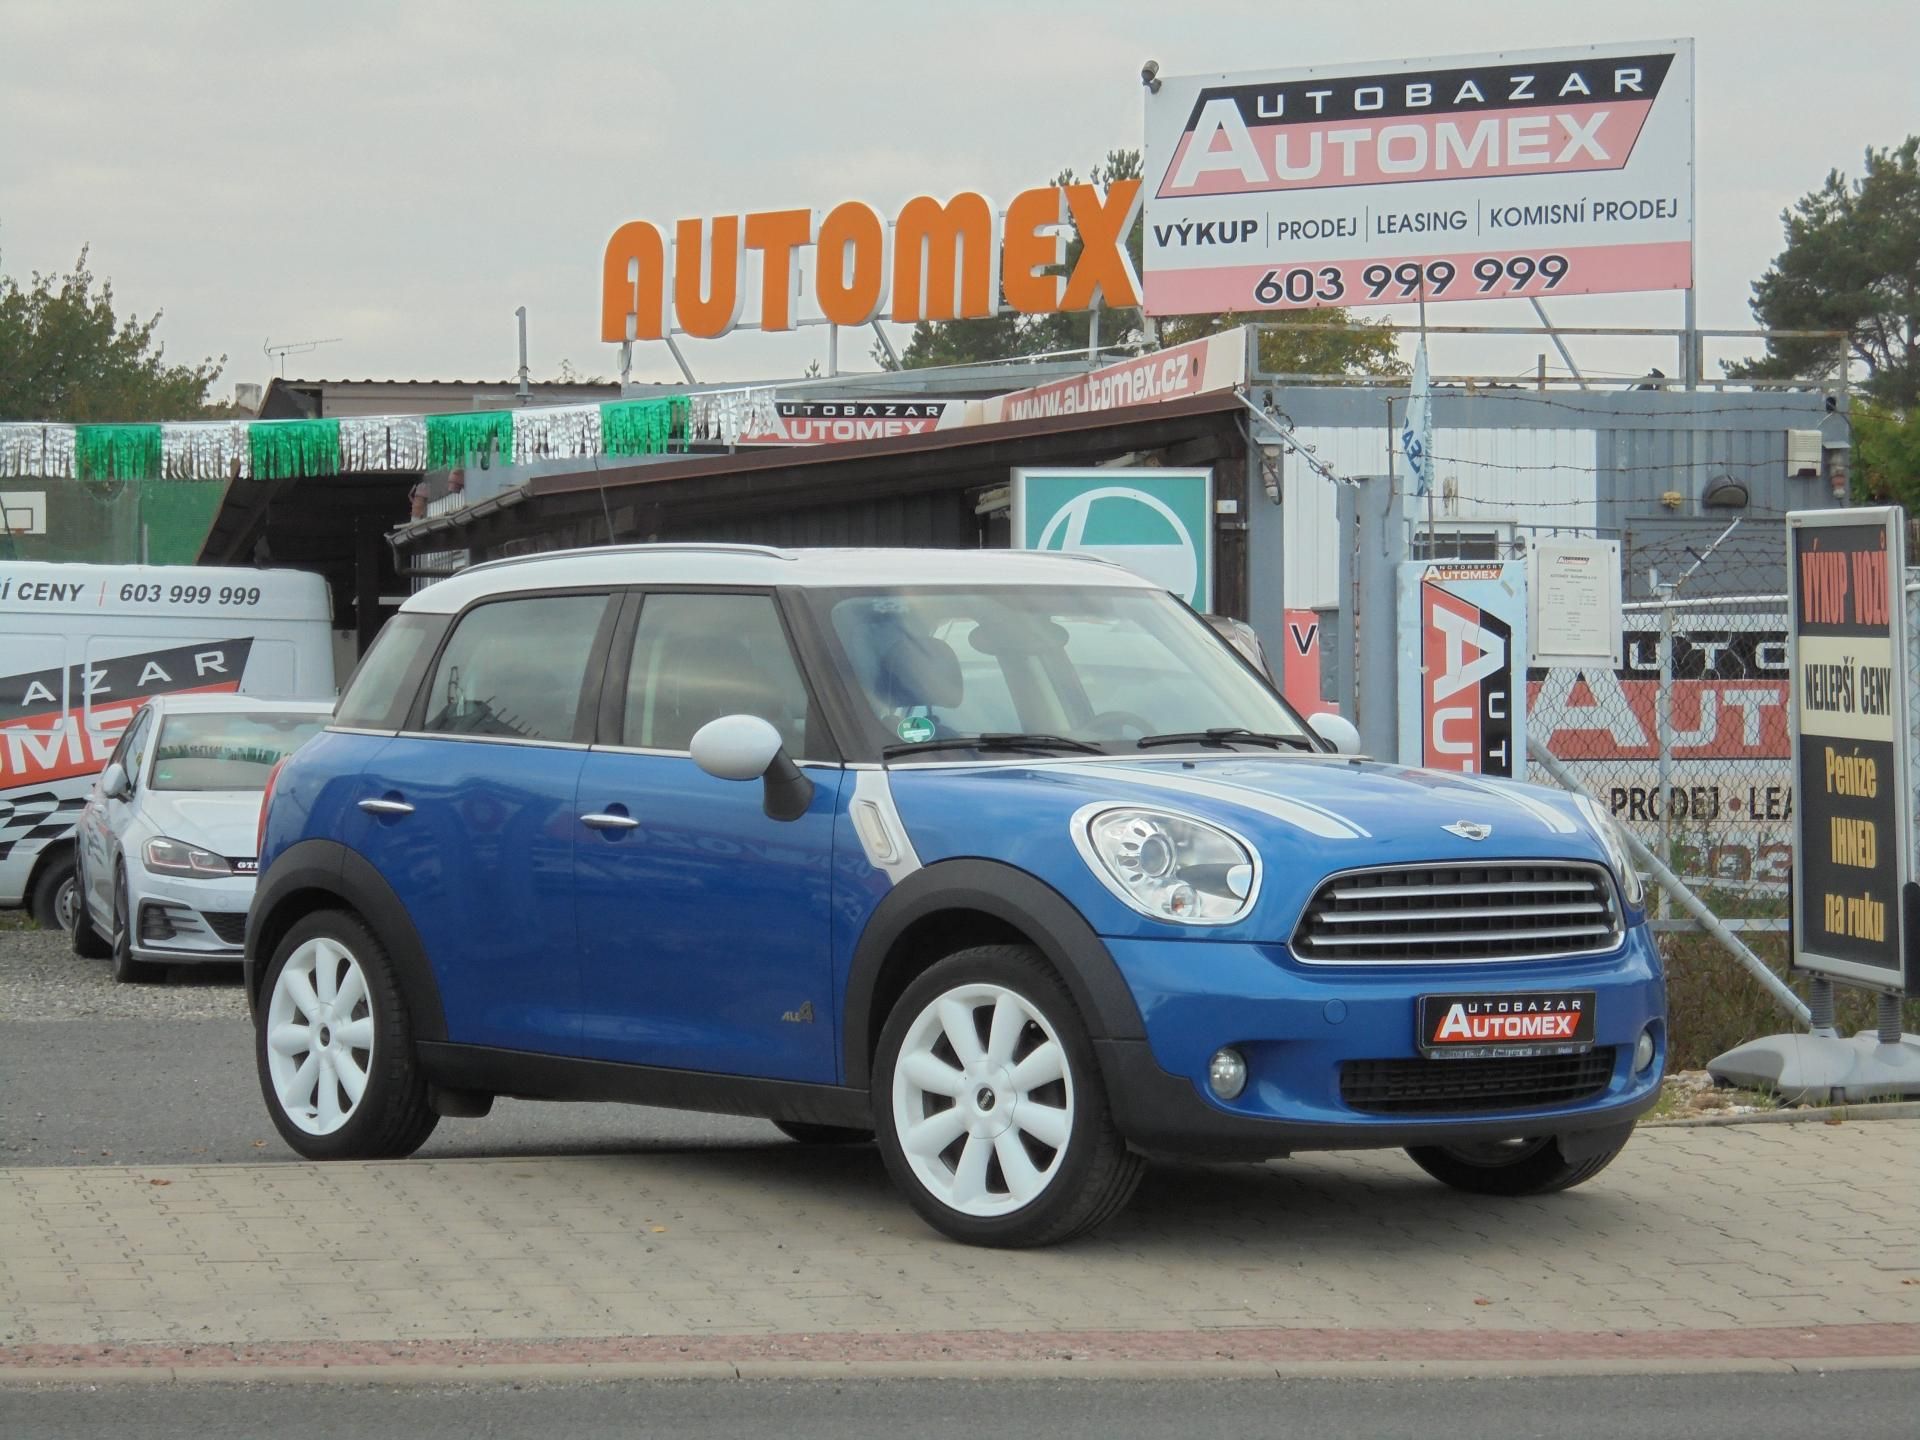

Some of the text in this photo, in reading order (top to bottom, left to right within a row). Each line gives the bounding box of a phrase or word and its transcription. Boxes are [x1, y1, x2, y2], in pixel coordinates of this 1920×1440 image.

[1170, 98, 1612, 188] AUTOMEX
[1153, 197, 1678, 248] VÝKUP PRODEJ LEASING KOMISNÍ PRODEJ
[600, 179, 1144, 343] AUTOMEX
[1253, 254, 1570, 305] 603 999 999
[1011, 353, 1189, 422] www.automex.cz
[17, 582, 85, 602] CENY
[119, 583, 162, 602] 603
[168, 585, 212, 605] 999
[219, 587, 261, 606] 999
[1424, 565, 1498, 580] AUTOMEX
[1801, 529, 1889, 625] VÝKUP VOZŮ
[1433, 603, 1505, 773] AU
[1527, 668, 1791, 748] AUT
[1805, 656, 1891, 716] NEJLEPŠÍ CENY
[1825, 746, 1877, 799] Peníze
[1831, 816, 1877, 869] IHNED
[1824, 891, 1884, 942] na ruku
[1439, 1003, 1571, 1039] AUTOMEX
